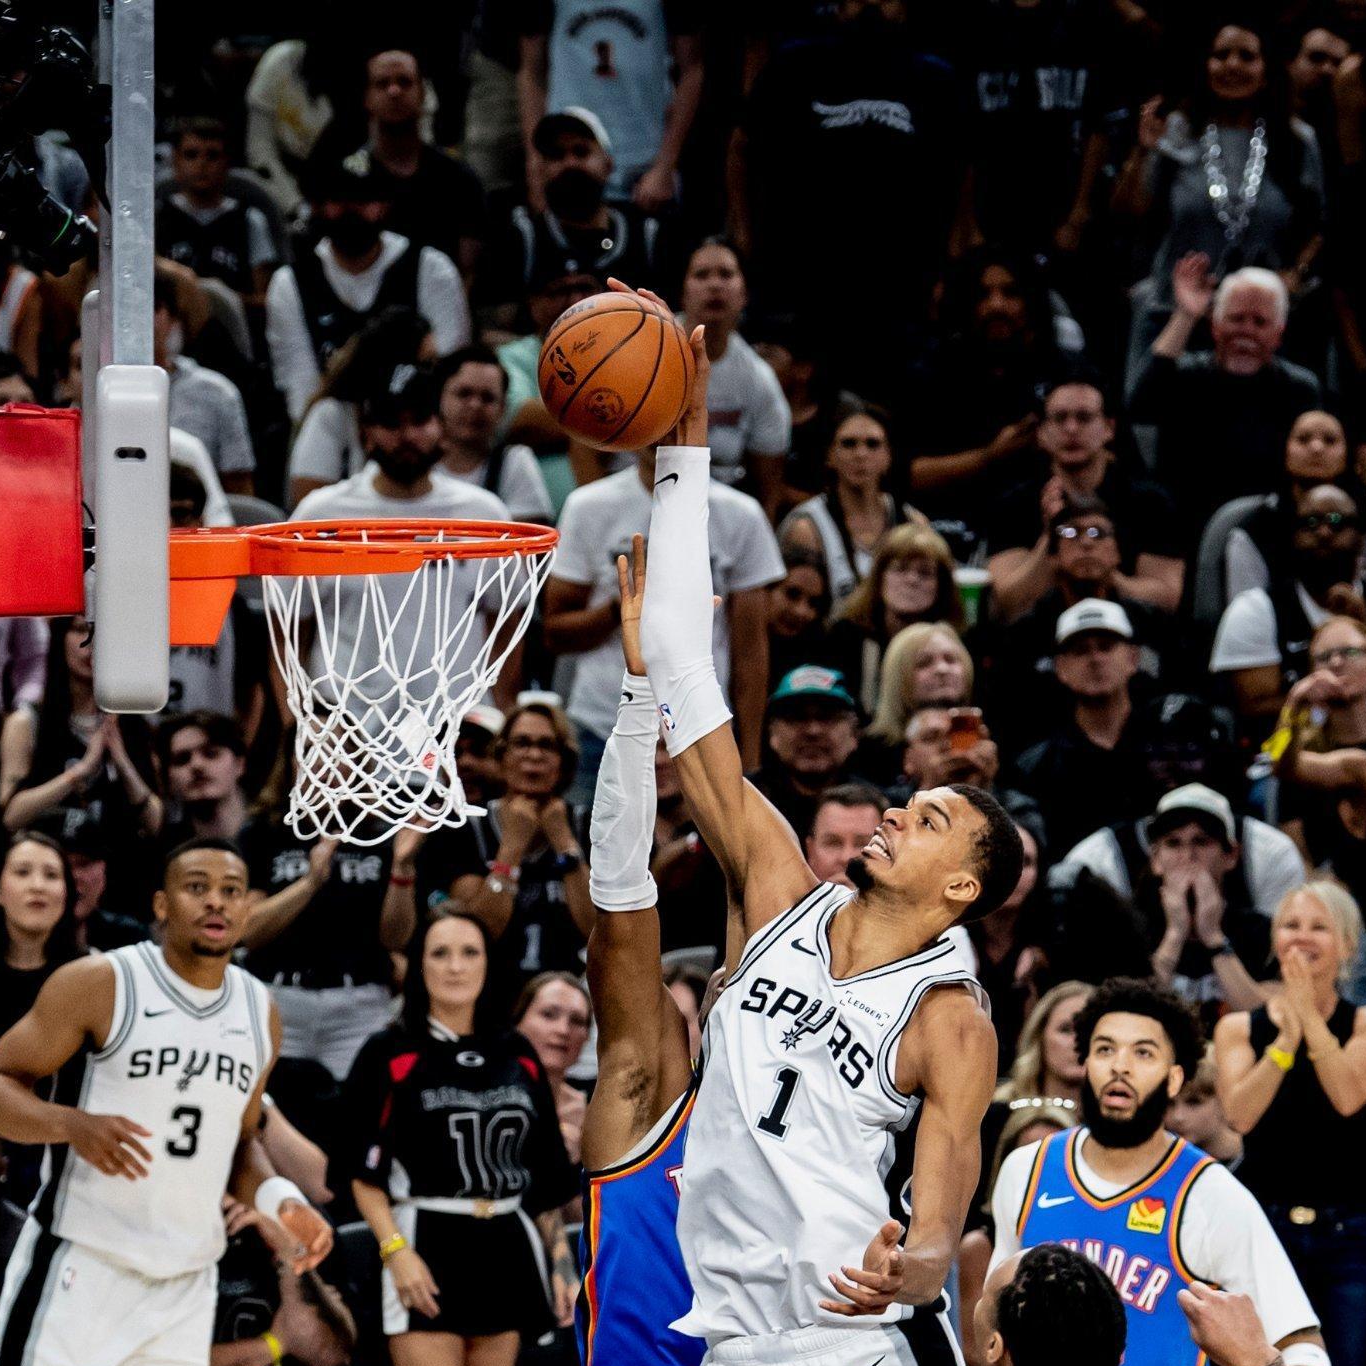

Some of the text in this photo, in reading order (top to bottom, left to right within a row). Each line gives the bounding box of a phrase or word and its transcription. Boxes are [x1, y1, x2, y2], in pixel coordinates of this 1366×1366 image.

[741, 976, 875, 1090] SPURS
[847, 997, 882, 1020] LEDGER
[128, 1047, 253, 1093] SPURS
[756, 1063, 803, 1142] 1
[166, 1106, 202, 1158] 3
